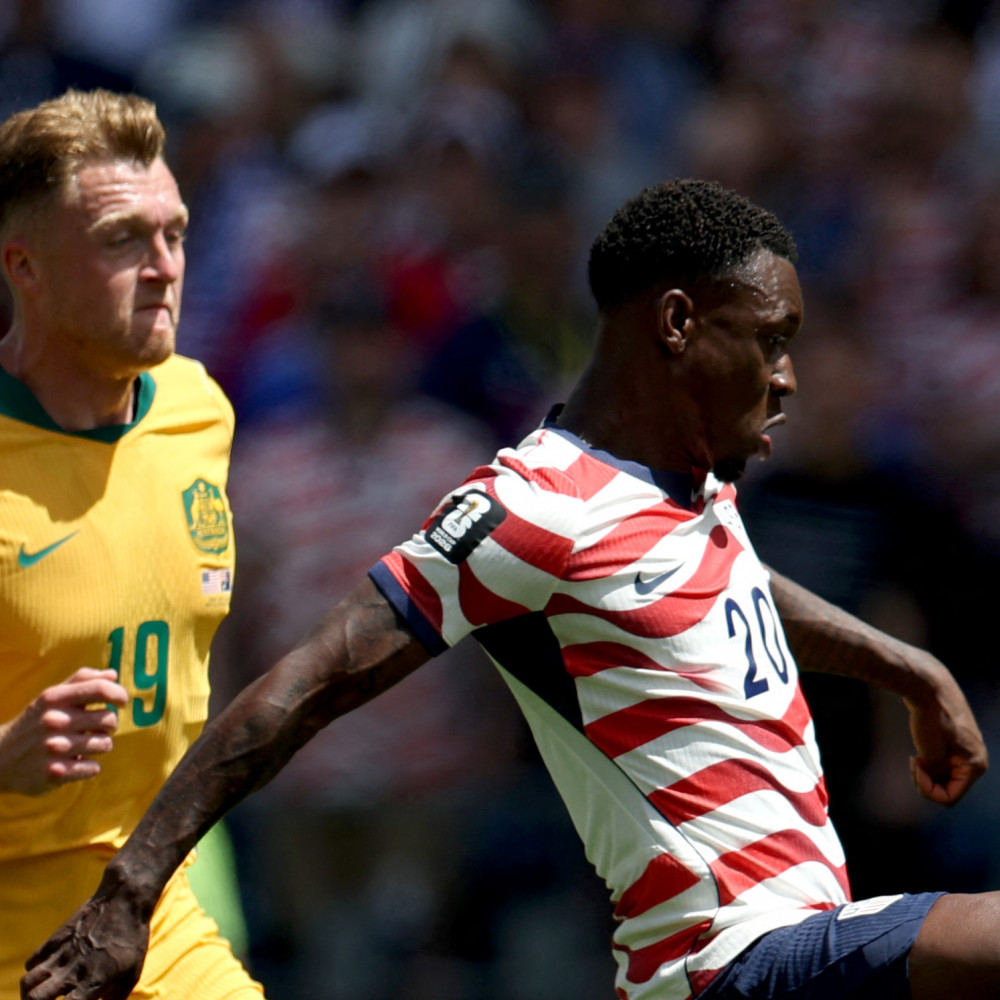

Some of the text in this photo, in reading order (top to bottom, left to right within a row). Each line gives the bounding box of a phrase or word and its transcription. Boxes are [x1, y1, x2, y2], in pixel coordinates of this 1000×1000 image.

[430, 531, 453, 553] 2026
[107, 619, 168, 728] 19
[724, 586, 789, 700] 20
